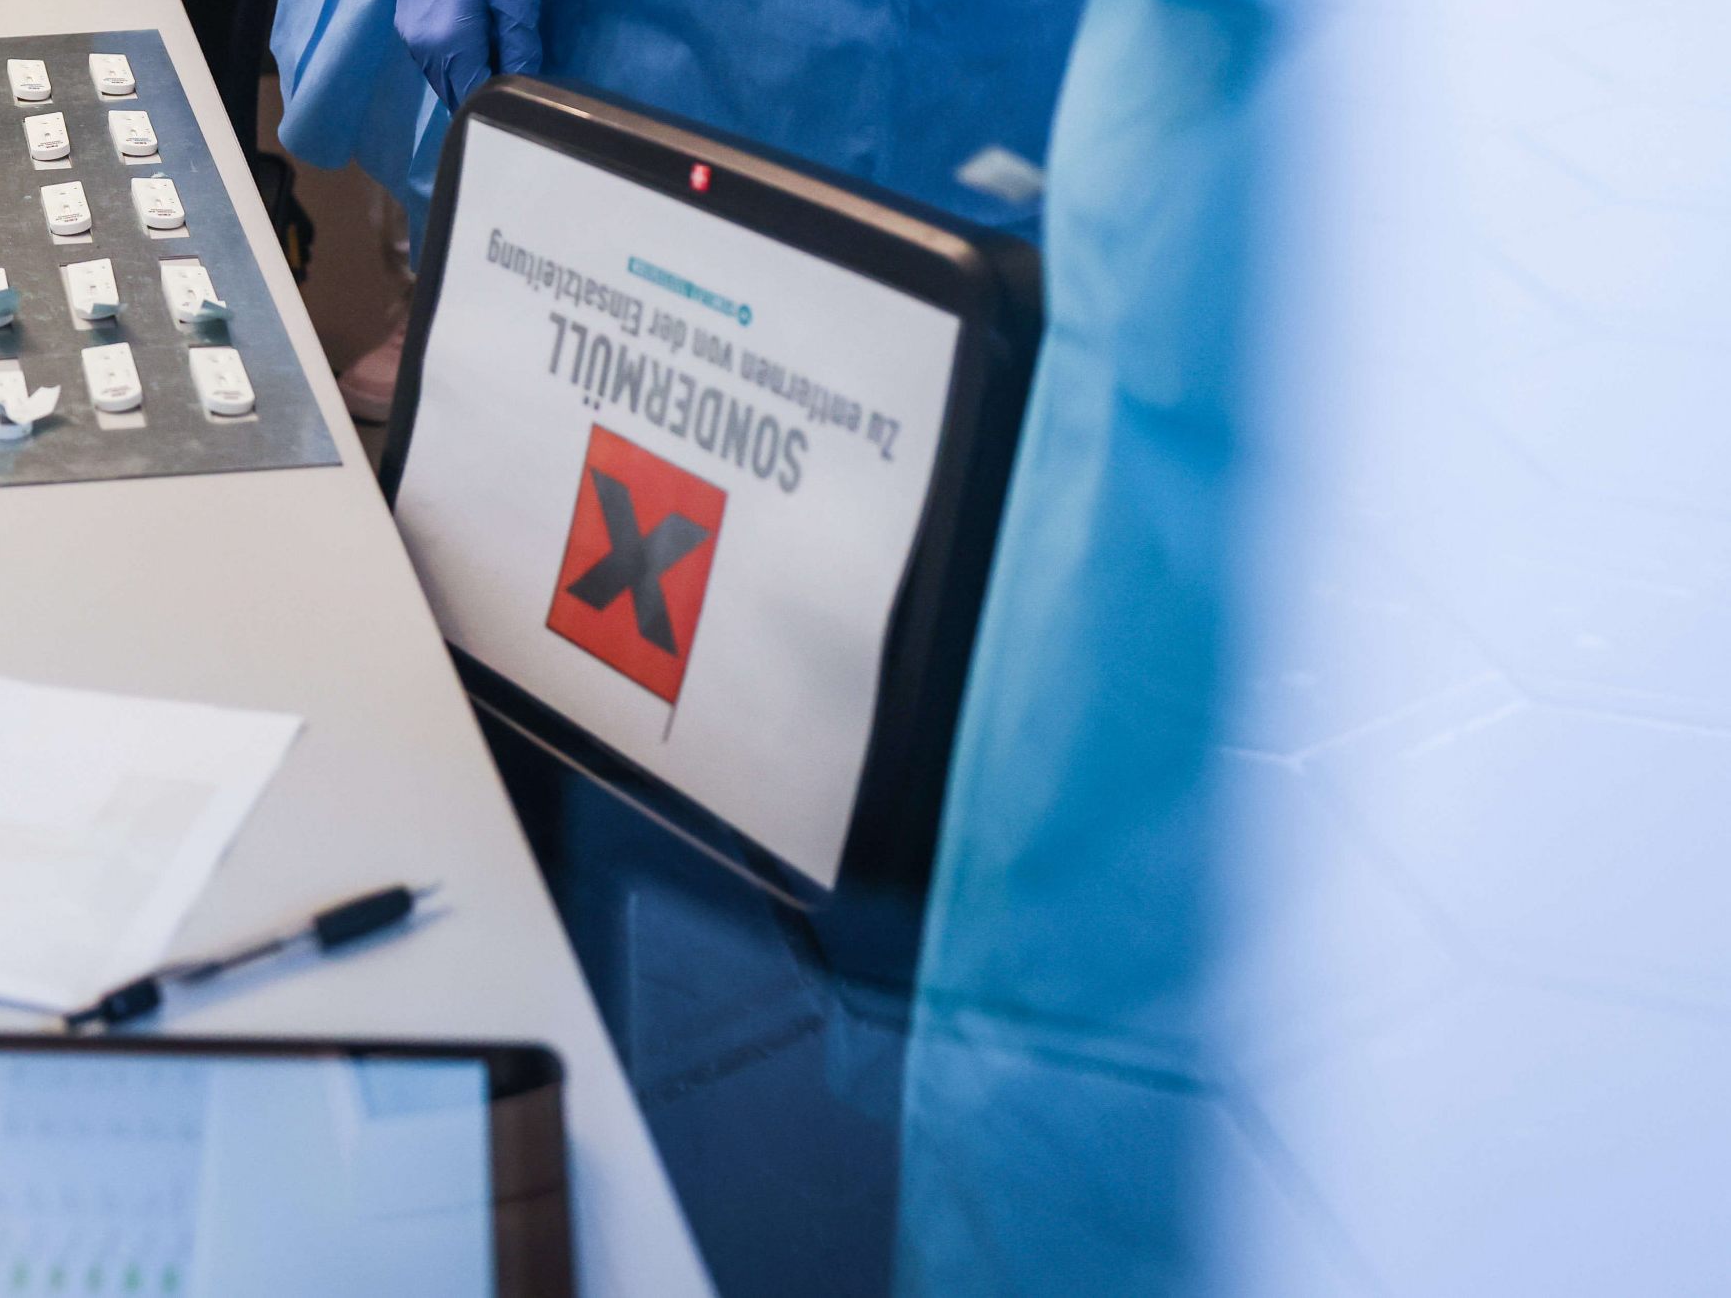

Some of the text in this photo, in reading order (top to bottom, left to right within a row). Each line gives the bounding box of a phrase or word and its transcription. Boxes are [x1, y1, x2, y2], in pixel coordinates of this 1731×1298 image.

[485, 227, 645, 337] Einsatzleitung
[646, 306, 687, 354] der
[691, 325, 734, 373] von
[548, 310, 809, 494] SONDERMÜLL
[740, 349, 863, 433] entfernen
[865, 410, 902, 462] Zu
